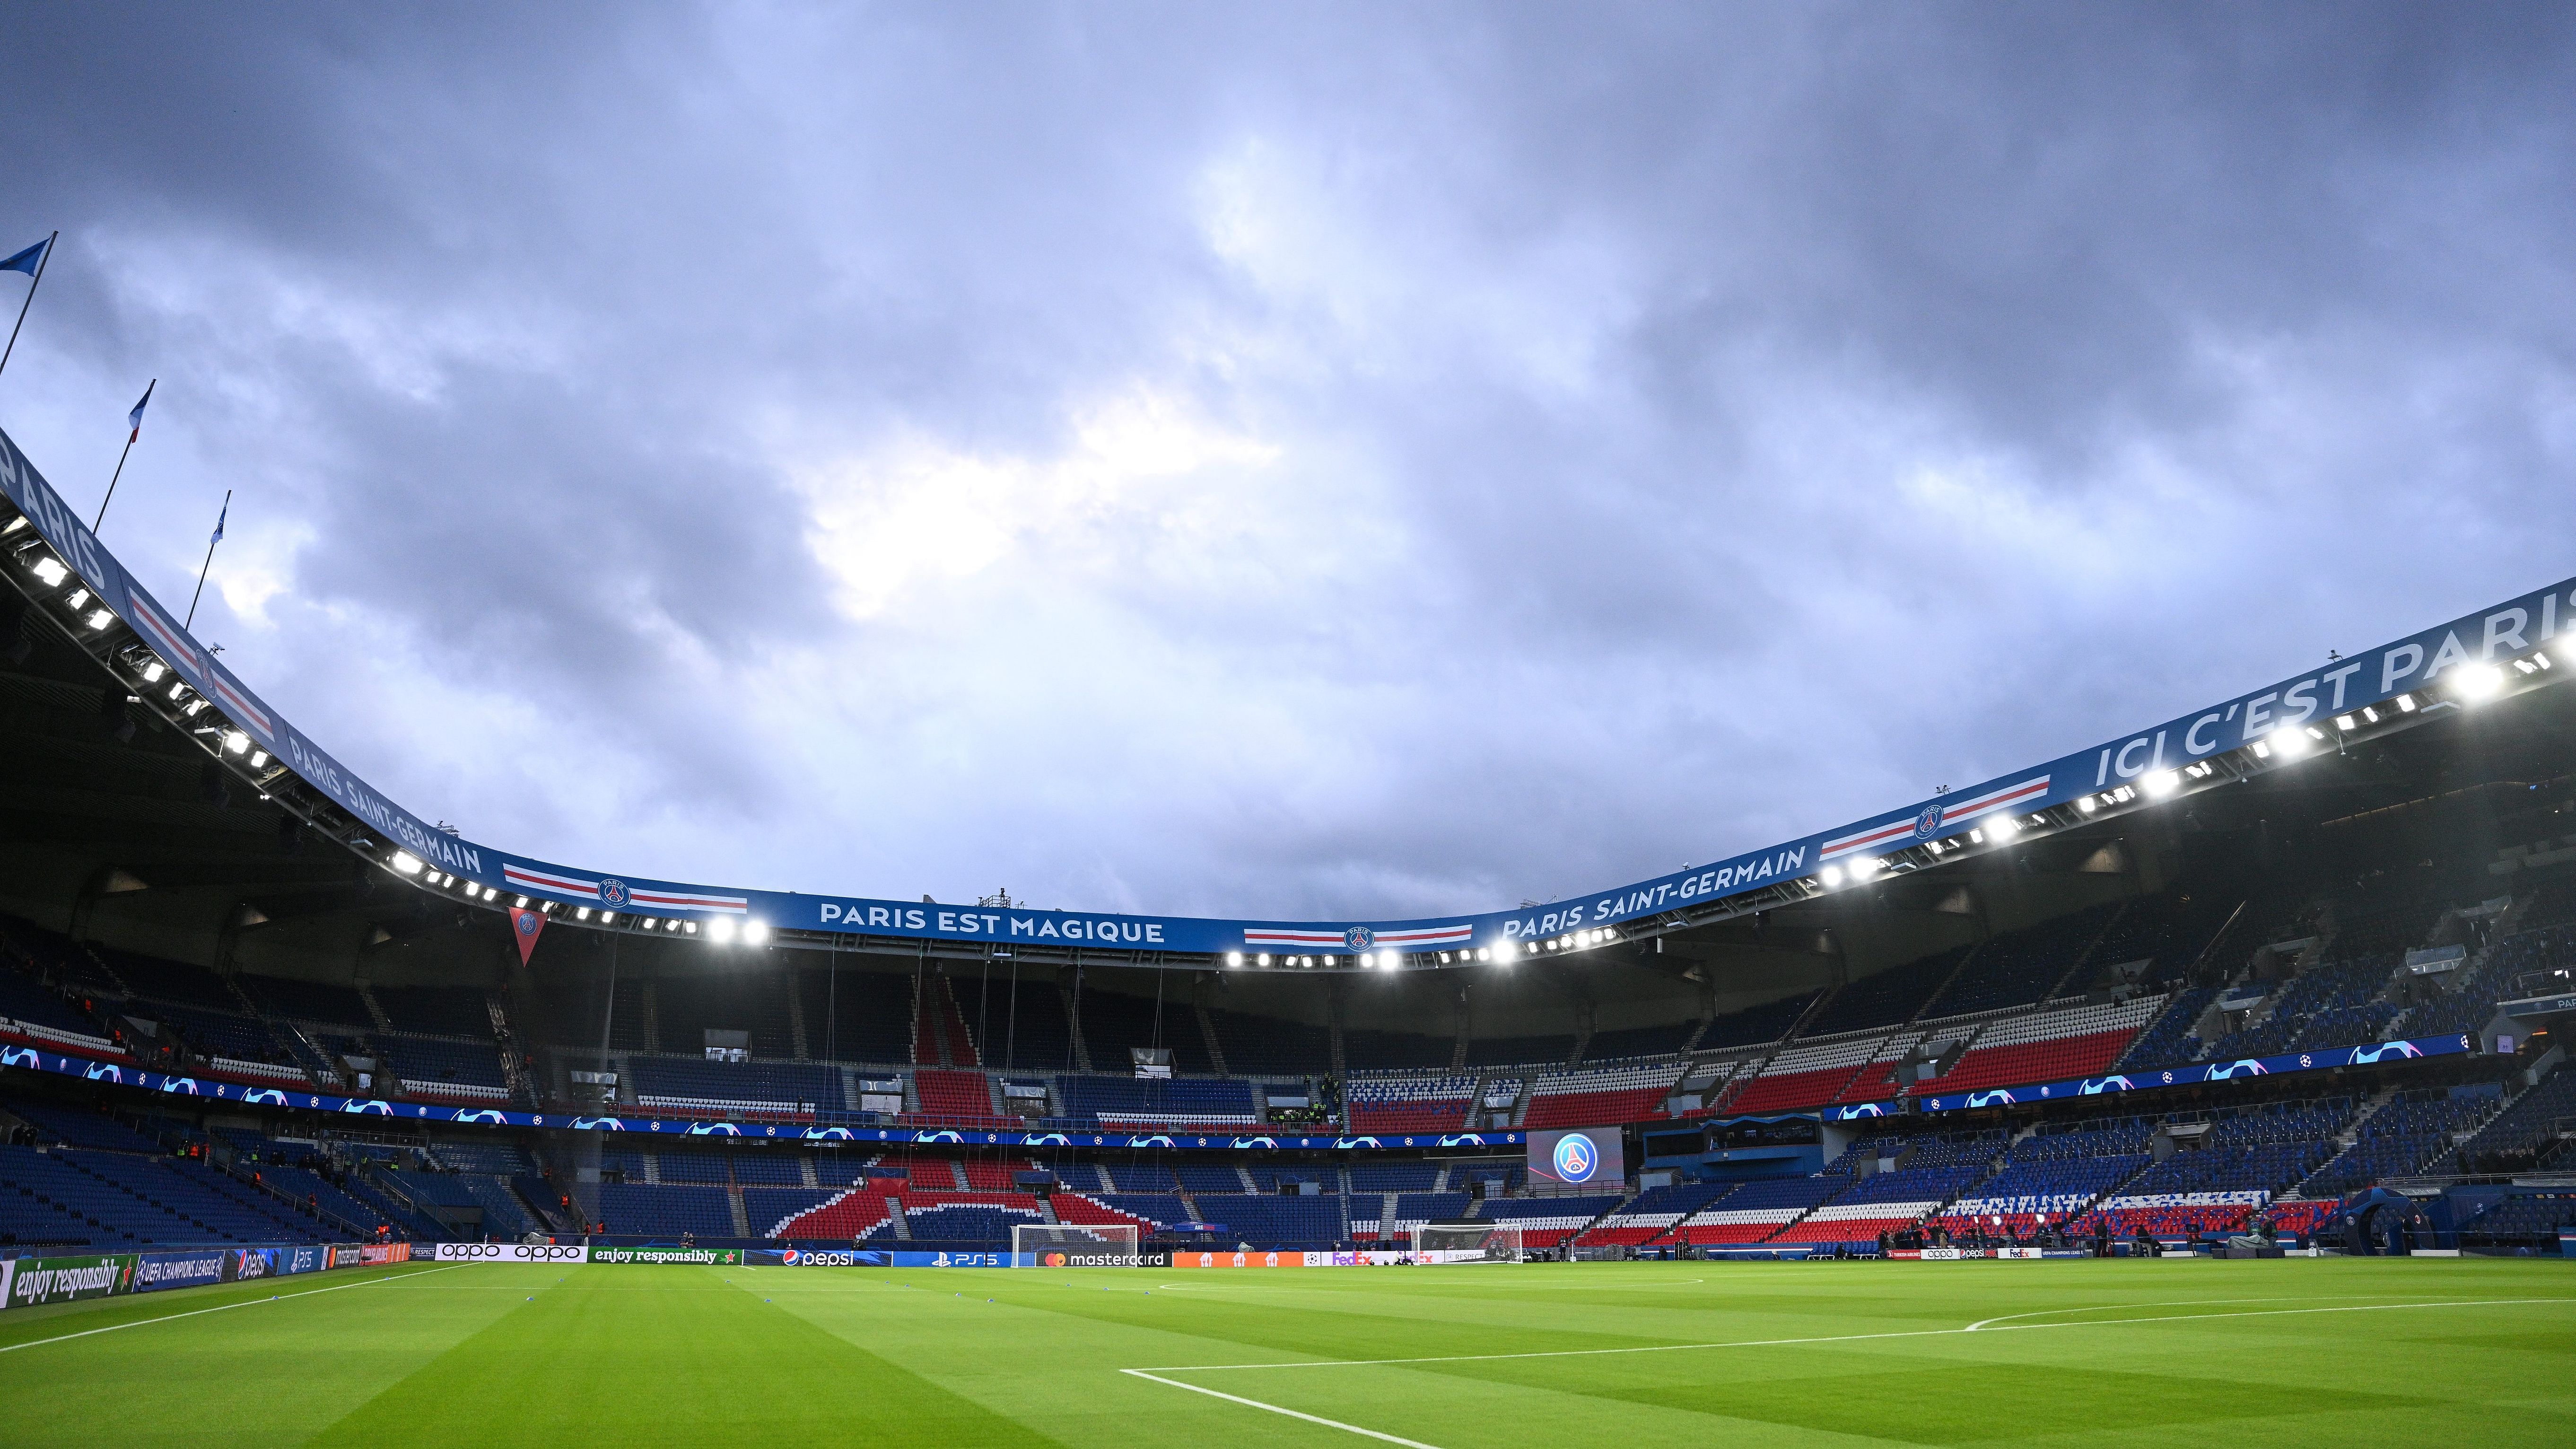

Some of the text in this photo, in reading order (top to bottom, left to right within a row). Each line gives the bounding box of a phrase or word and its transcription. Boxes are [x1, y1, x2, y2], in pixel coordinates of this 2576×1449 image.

[2096, 588, 2576, 786] ICI C'EST PARI
[290, 736, 481, 873] PARIS SAINT-GERMAIN
[1922, 807, 1940, 817] PARIS
[603, 881, 624, 889] PARIS
[1502, 847, 1805, 939] PARIS SAINT-GERMAIN
[821, 904, 1164, 942] PARIS EST MAGIQUE
[298, 1251, 313, 1268] PS5
[336, 1246, 361, 1265] mastercard
[442, 1244, 580, 1261] oppo oppo
[595, 1249, 717, 1264] enjoy responsibly
[803, 1250, 854, 1266] pepsi
[955, 1254, 997, 1265] PS5
[1071, 1253, 1164, 1266] mastercard
[1333, 1252, 1371, 1265] FedEx
[1928, 1250, 1952, 1259] oppo
[1966, 1248, 1984, 1259] pepsi
[2010, 1249, 2029, 1257] FedEx
[145, 1259, 217, 1282] UEFA CHAMPIONS LEAGUE
[245, 1249, 267, 1279] pepsi
[17, 1261, 54, 1304] enjoy
[52, 1258, 119, 1299] responsibly
